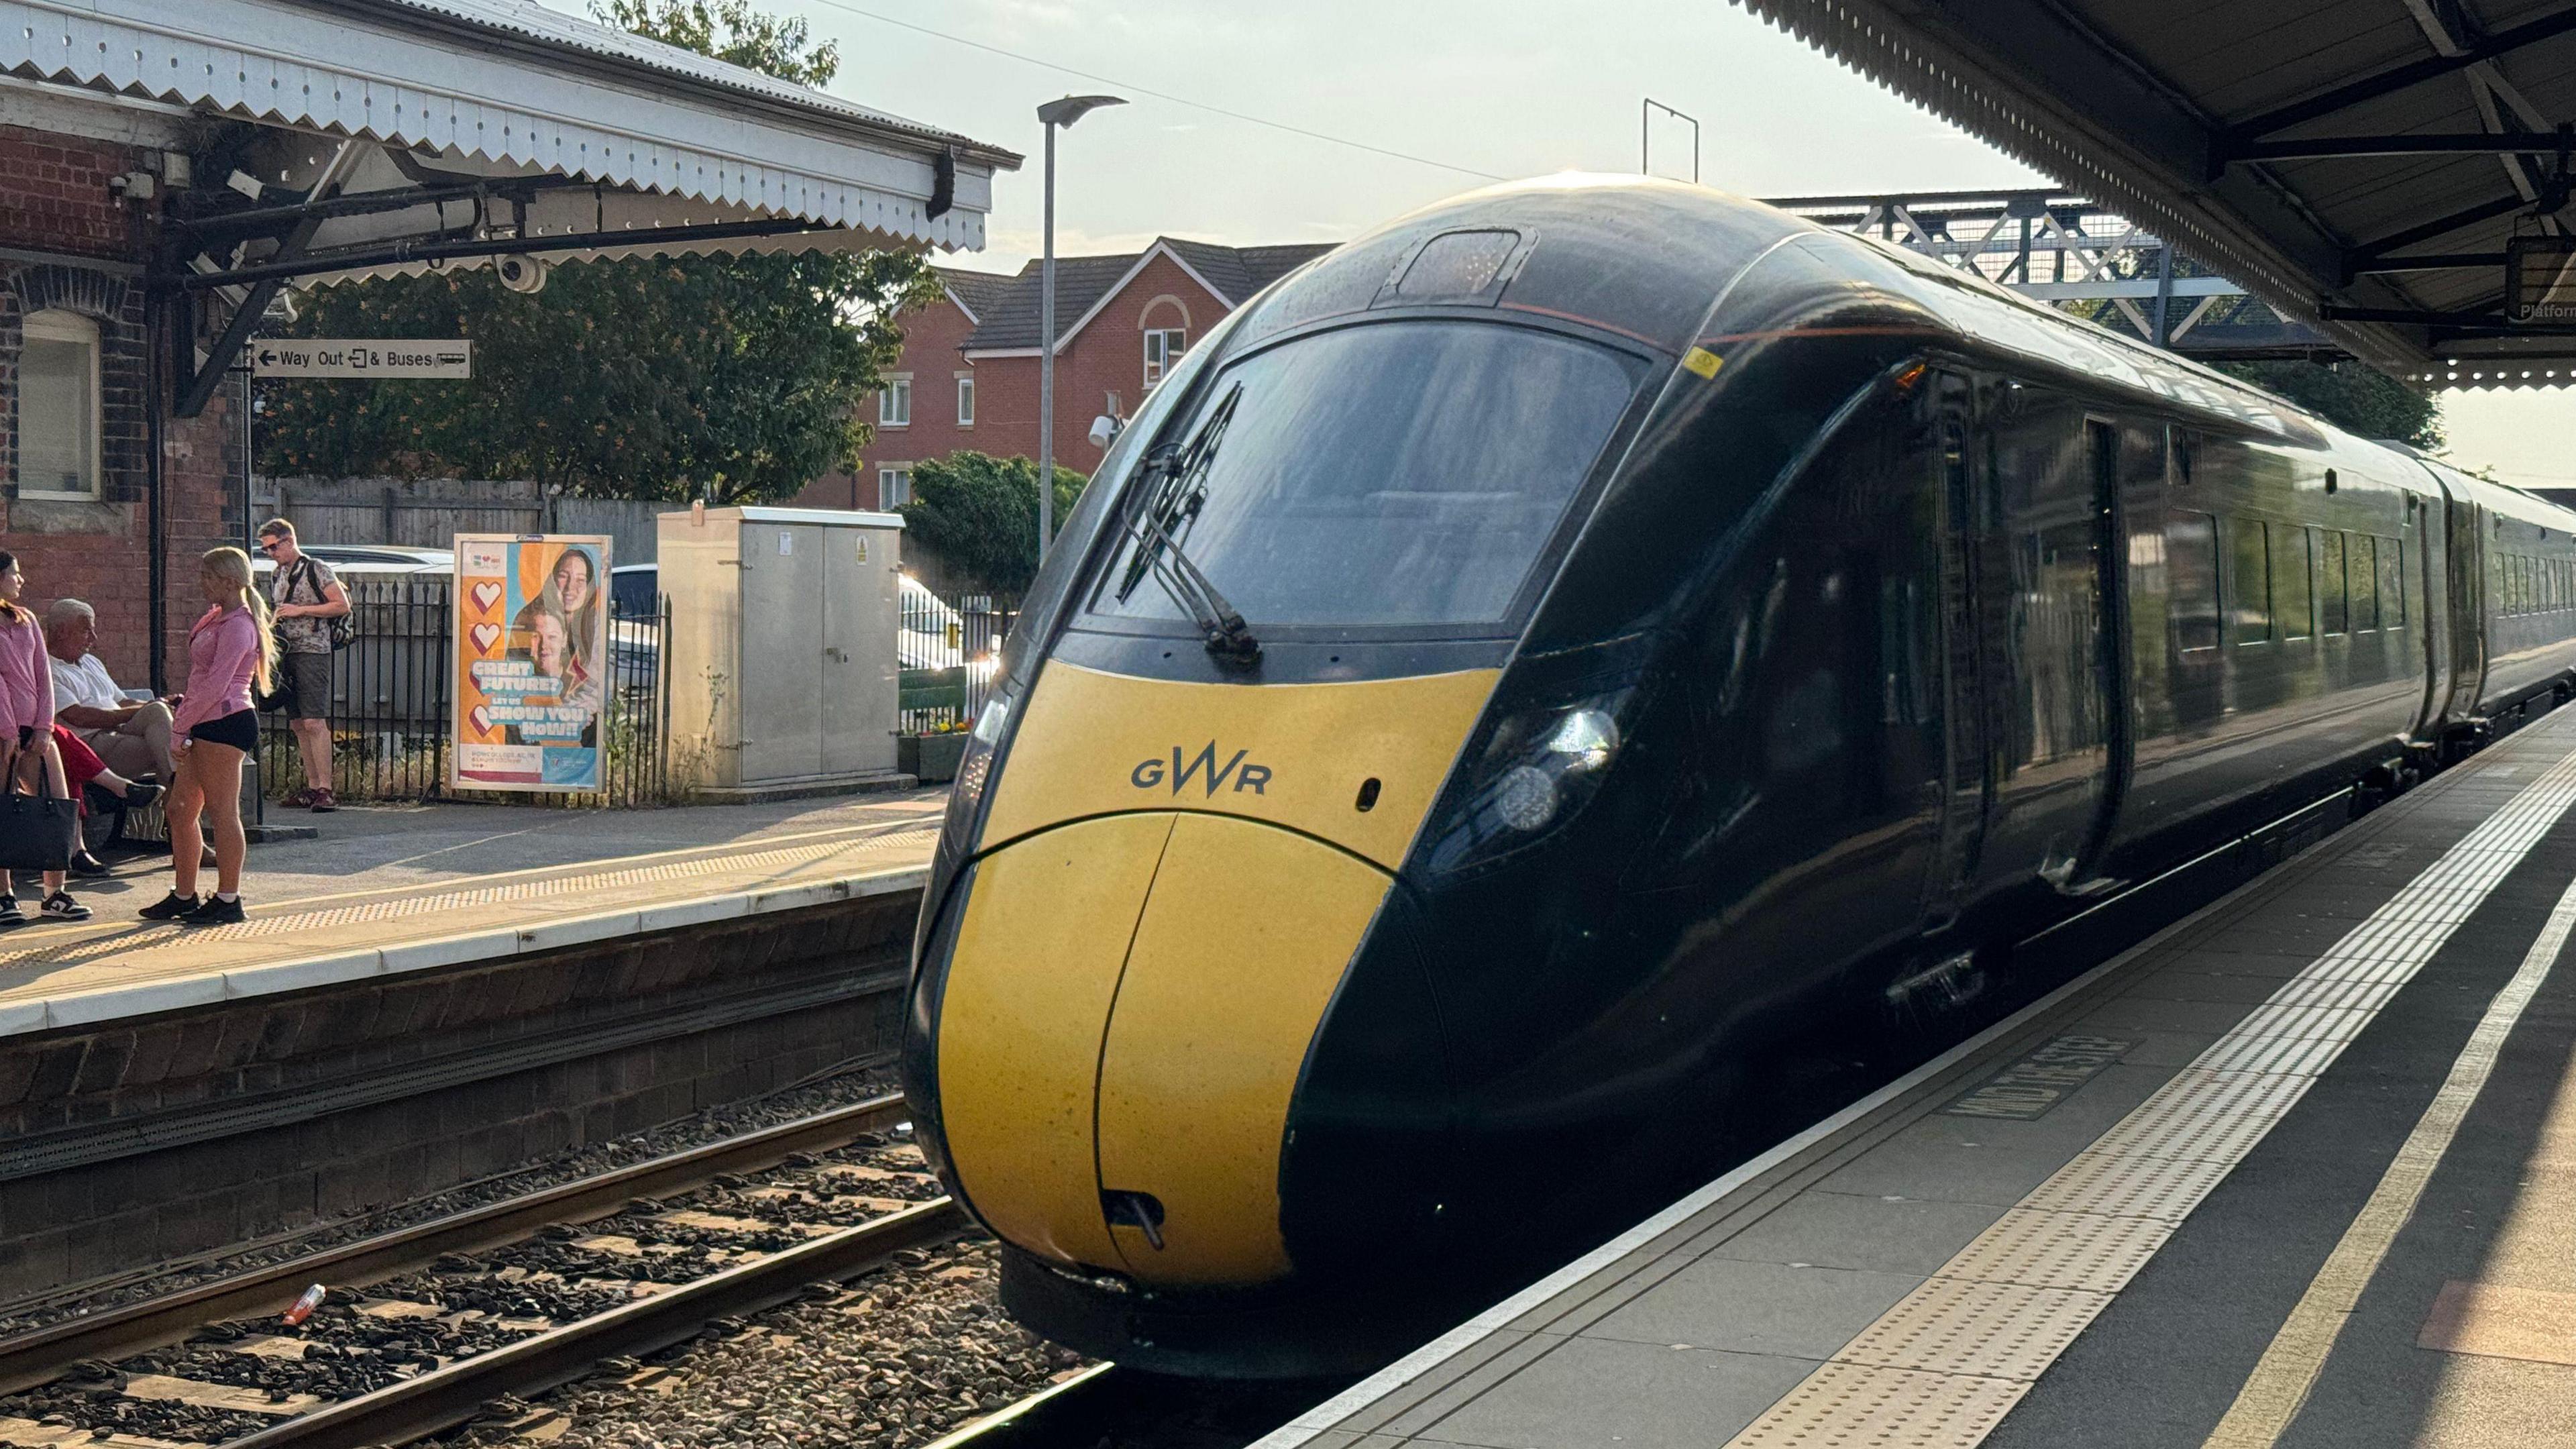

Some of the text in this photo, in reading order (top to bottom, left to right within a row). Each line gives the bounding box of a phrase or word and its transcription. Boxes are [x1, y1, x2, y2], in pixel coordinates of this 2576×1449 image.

[280, 351, 432, 368] Way Out & Buses
[472, 661, 530, 676] GREAT
[481, 676, 559, 692] FUTURE?
[488, 706, 584, 722] SHOW YOU
[1131, 739, 1272, 799] GWR
[1948, 1035, 2130, 1118] MIND THE STEP
